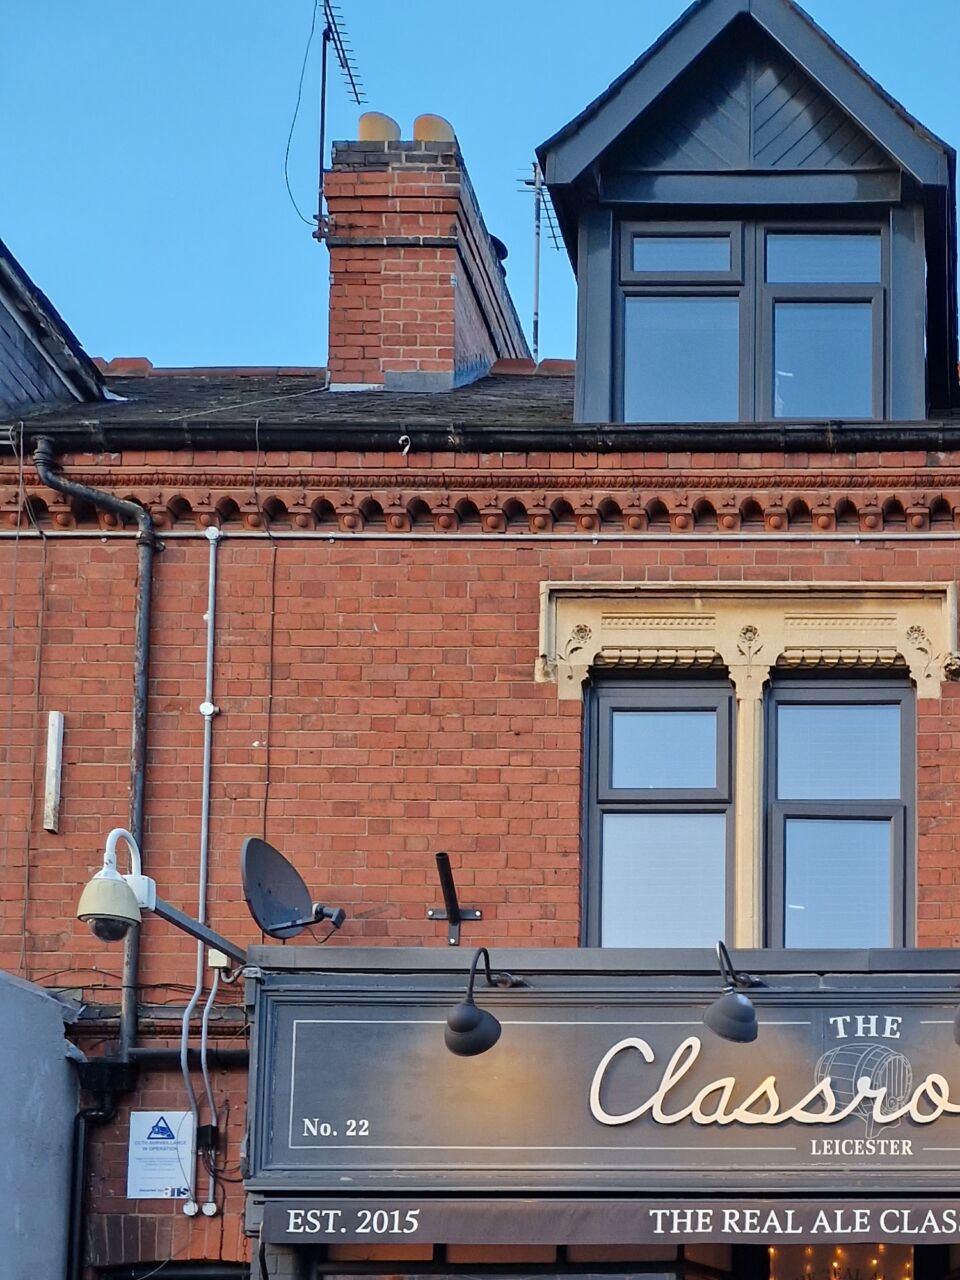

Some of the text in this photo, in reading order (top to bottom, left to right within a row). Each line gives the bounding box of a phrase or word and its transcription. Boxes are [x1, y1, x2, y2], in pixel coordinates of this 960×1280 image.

[829, 1015, 902, 1038] THE
[302, 1118, 369, 1136] No. 22
[811, 1139, 914, 1155] LEICESTER
[286, 1209, 420, 1233] EST. 2015
[650, 1209, 713, 1233] THE
[721, 1209, 803, 1233] REAL
[810, 1209, 871, 1233] ALE
